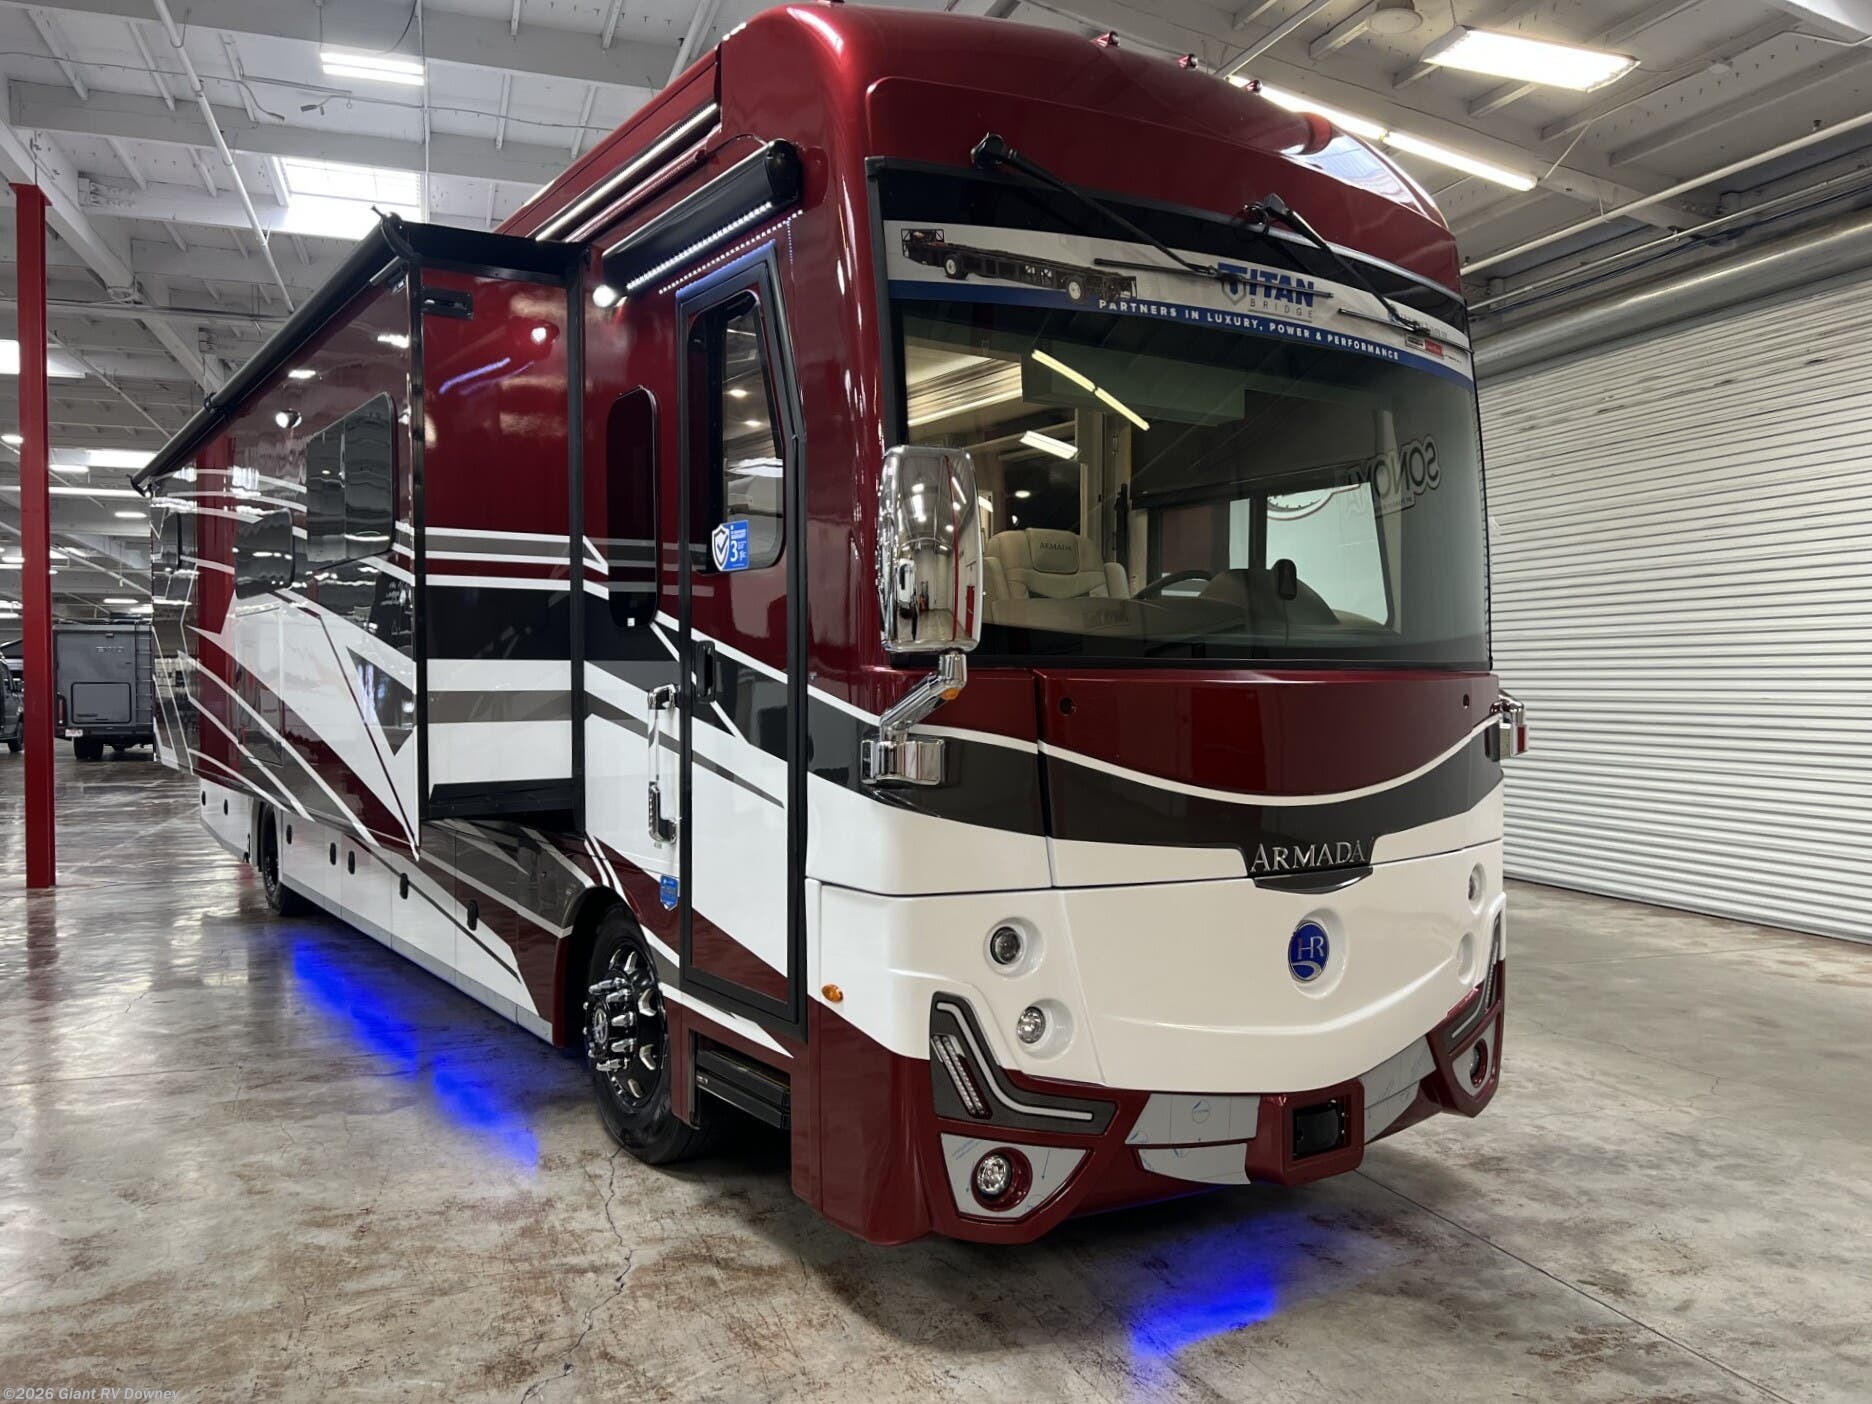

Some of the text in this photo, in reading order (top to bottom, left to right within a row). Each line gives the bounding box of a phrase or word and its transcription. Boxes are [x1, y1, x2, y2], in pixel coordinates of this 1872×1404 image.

[1217, 261, 1314, 308] TITAN
[1250, 297, 1313, 319] BRIDGE
[1099, 300, 1177, 317] PARTNERS
[1184, 309, 1200, 321] IN
[1207, 312, 1263, 331] LUXURY,
[1269, 322, 1310, 338] POWER
[1315, 331, 1322, 341] &
[1327, 333, 1399, 361] PERFORMANCE
[730, 540, 738, 562] 3
[1250, 840, 1366, 873] ARMADA
